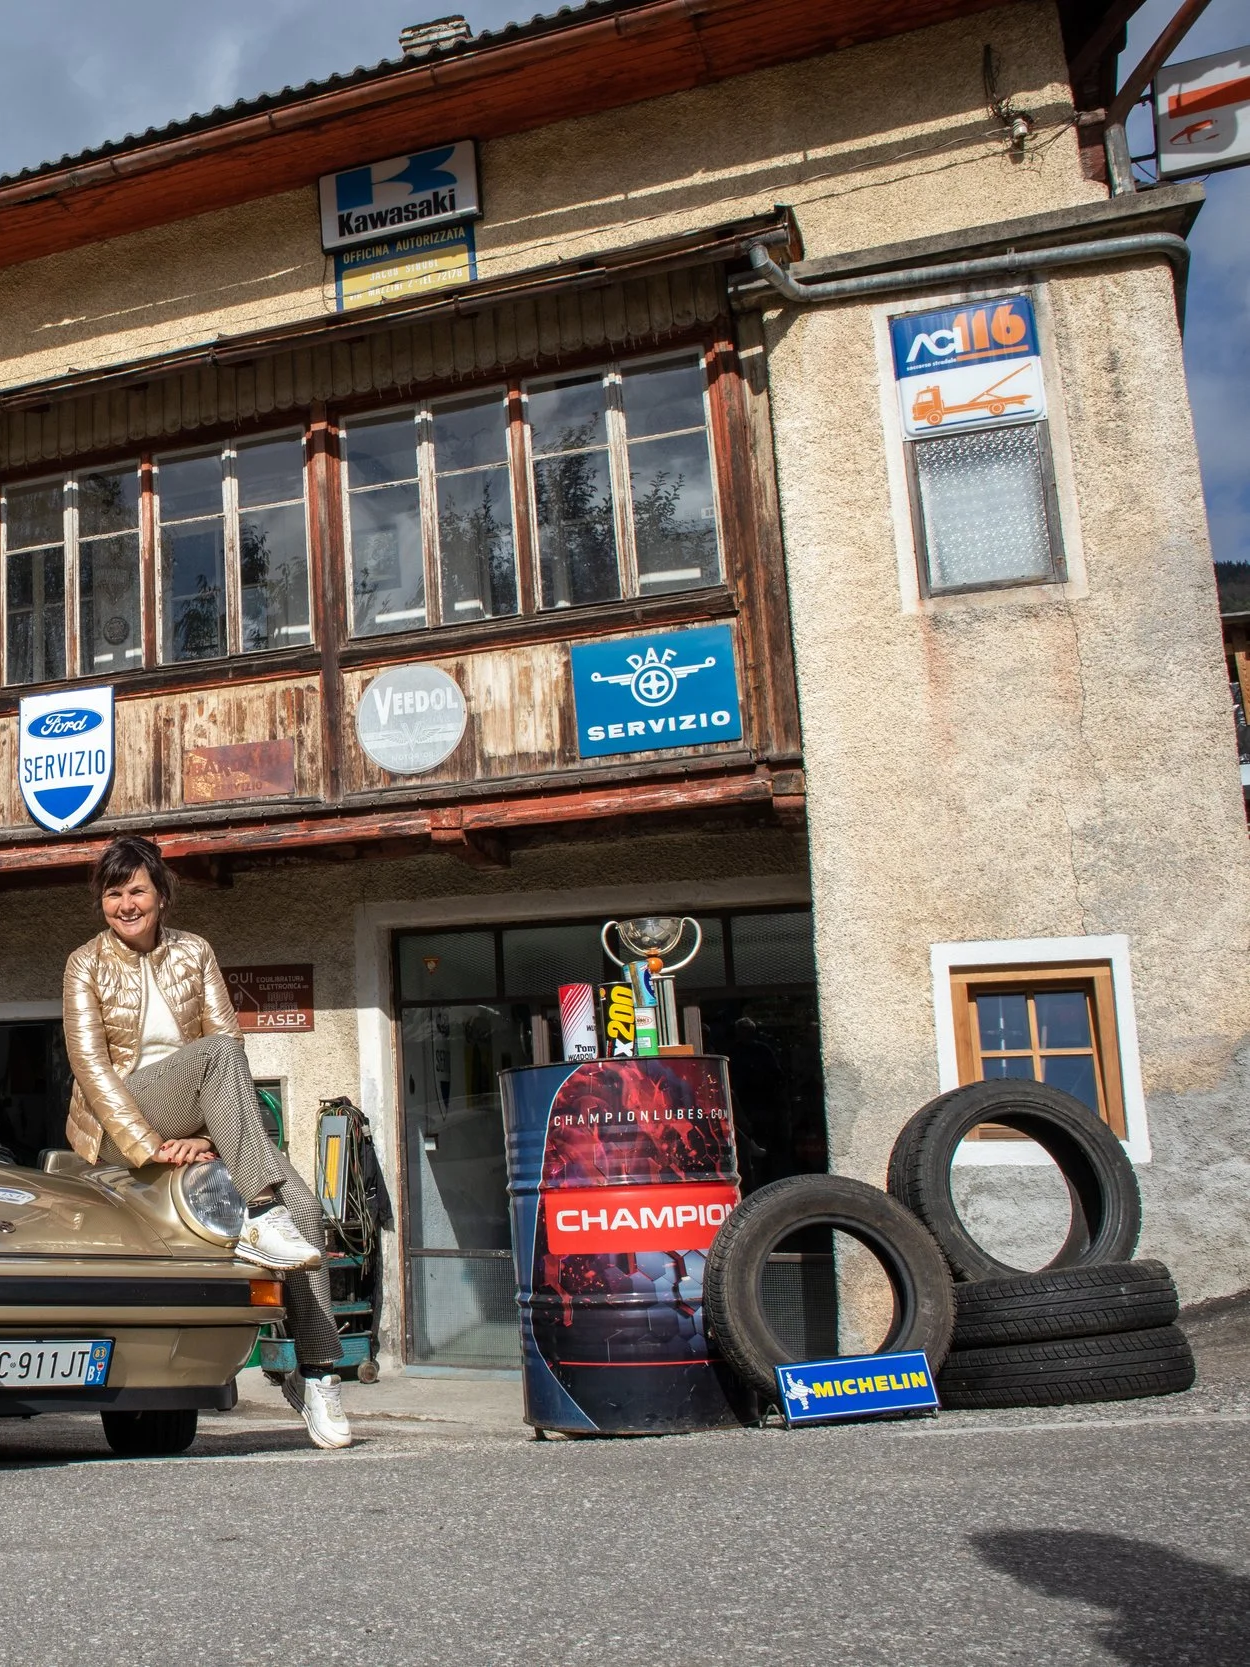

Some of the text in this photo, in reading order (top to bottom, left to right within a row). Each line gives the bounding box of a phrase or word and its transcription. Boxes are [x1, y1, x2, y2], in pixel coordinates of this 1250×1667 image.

[338, 189, 456, 238] Kawasaki
[343, 226, 466, 264] OFFICINA AUTORIZZATA
[906, 304, 1027, 363] ACI 116
[626, 647, 678, 670] DAF
[373, 686, 459, 726] VEEDOL
[40, 712, 89, 736] Ford
[587, 710, 731, 741] SERVIZIO
[24, 749, 105, 783] SERVIZIO
[228, 972, 253, 984] QUI
[258, 983, 302, 991] ELETTRONICA
[553, 1107, 729, 1127] CHAMPIONLUBES.COM
[812, 1371, 928, 1399] MICHELIN
